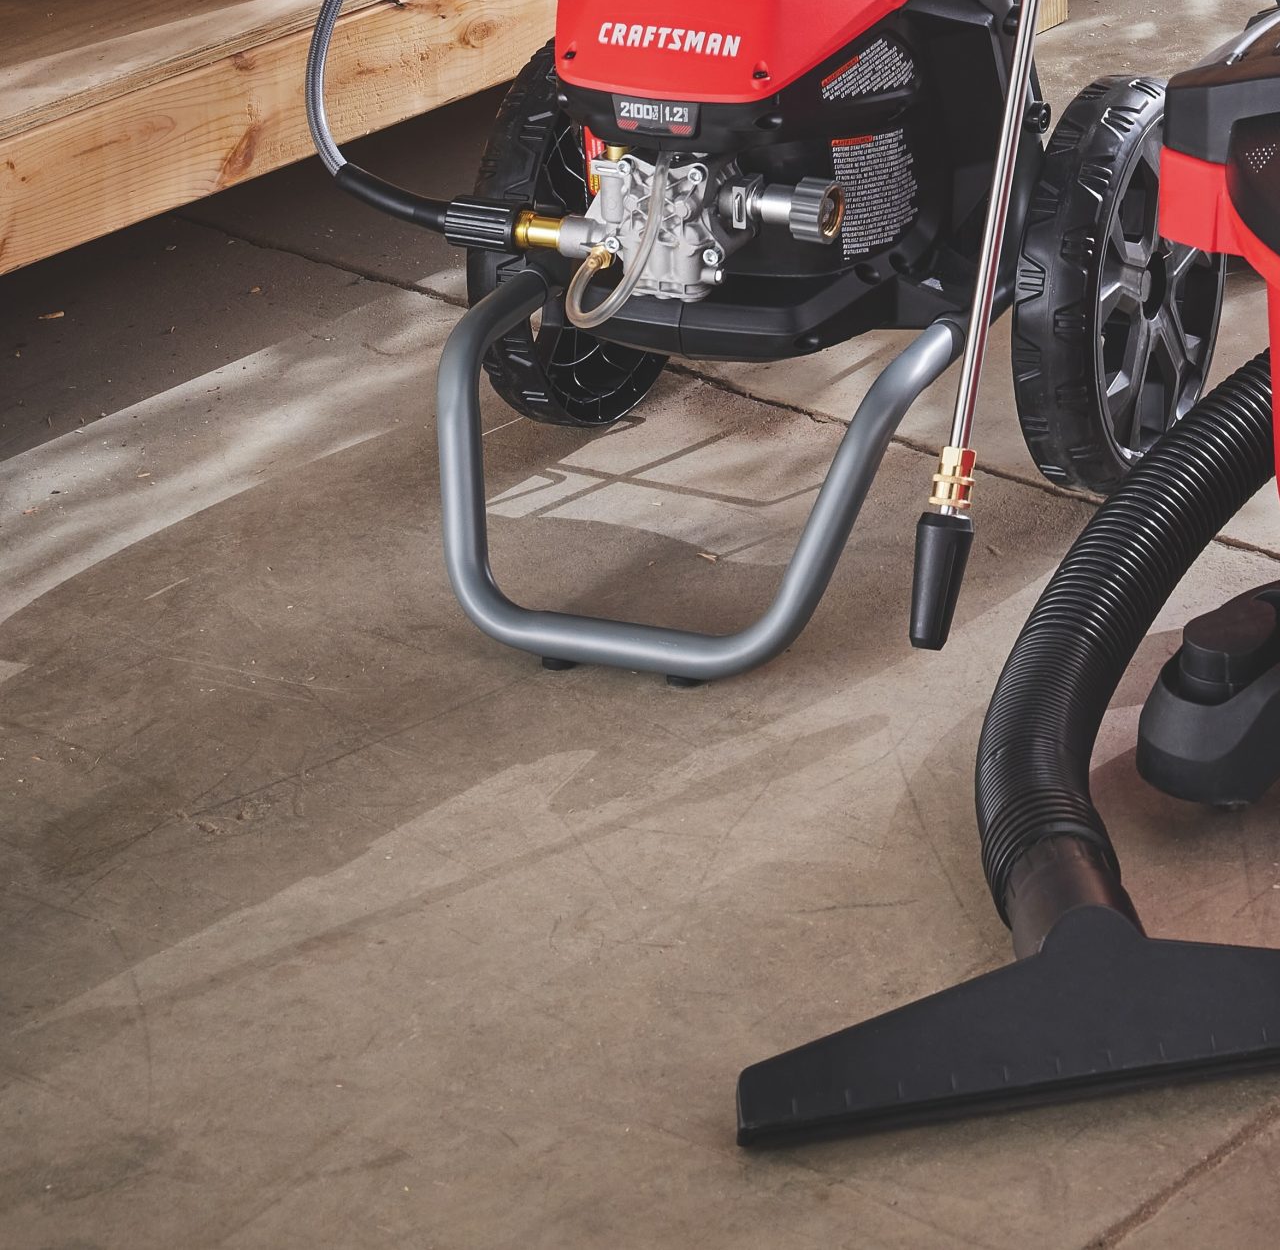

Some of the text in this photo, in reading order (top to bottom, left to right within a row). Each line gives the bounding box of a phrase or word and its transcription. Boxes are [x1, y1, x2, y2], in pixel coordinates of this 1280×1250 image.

[598, 22, 741, 57] CRAFTSMAN
[620, 102, 652, 120] 2100
[665, 106, 683, 122] 1.2
